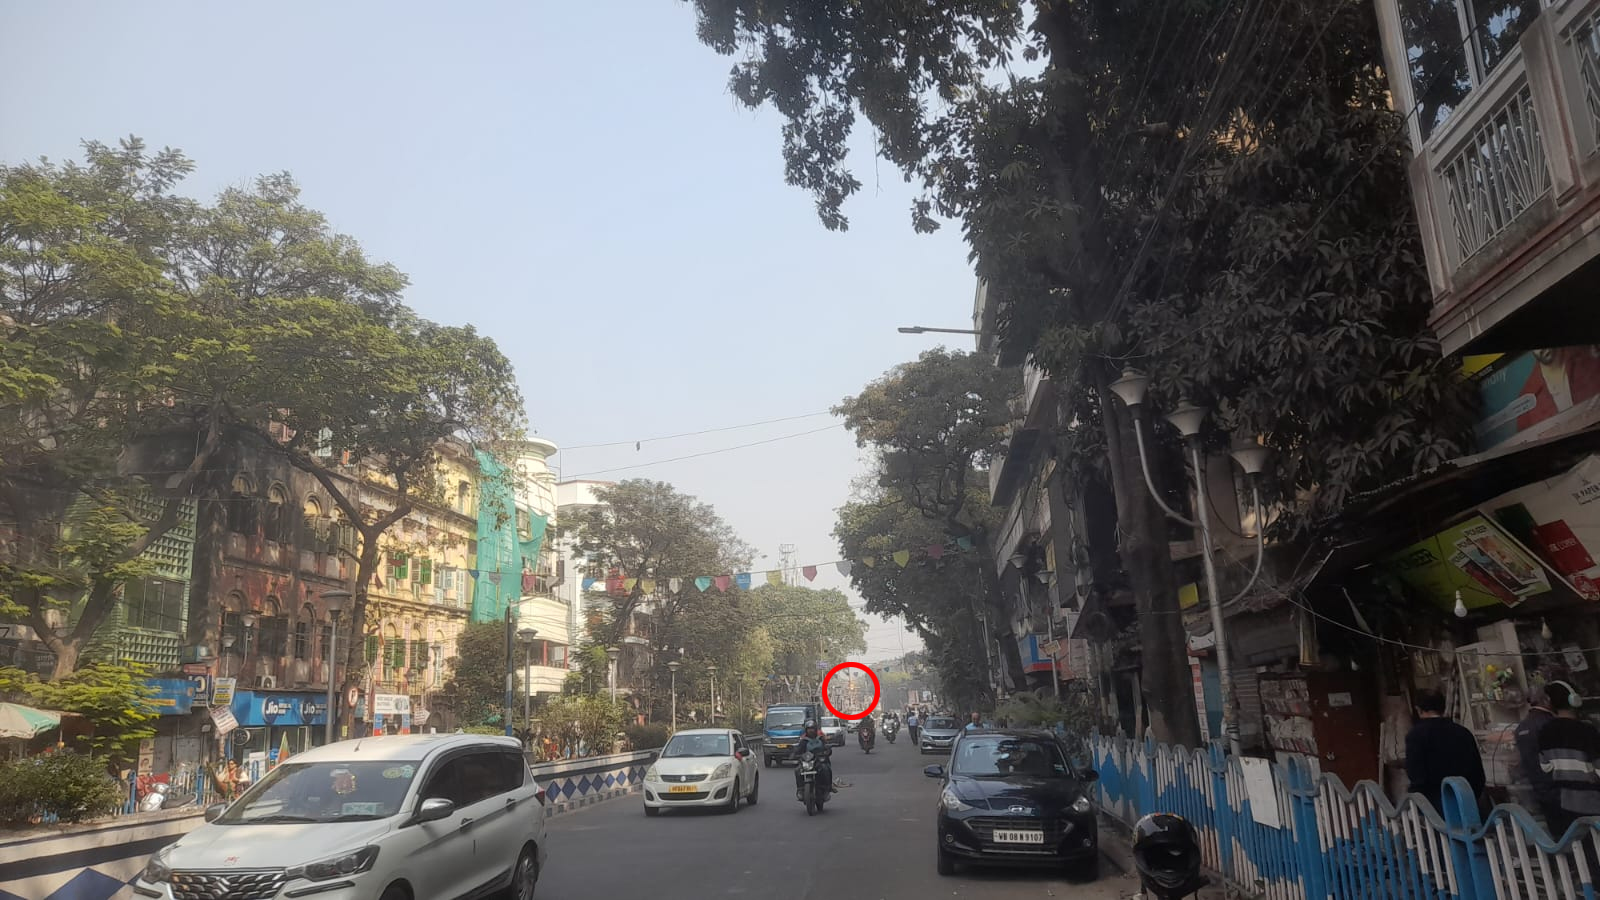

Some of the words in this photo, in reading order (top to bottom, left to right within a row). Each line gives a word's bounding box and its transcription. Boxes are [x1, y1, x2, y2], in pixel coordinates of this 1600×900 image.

[266, 701, 279, 714] Jio
[303, 702, 315, 714] Jio
[999, 832, 1008, 841] WB
[1009, 832, 1018, 841] 08
[1025, 833, 1043, 842] 9107
